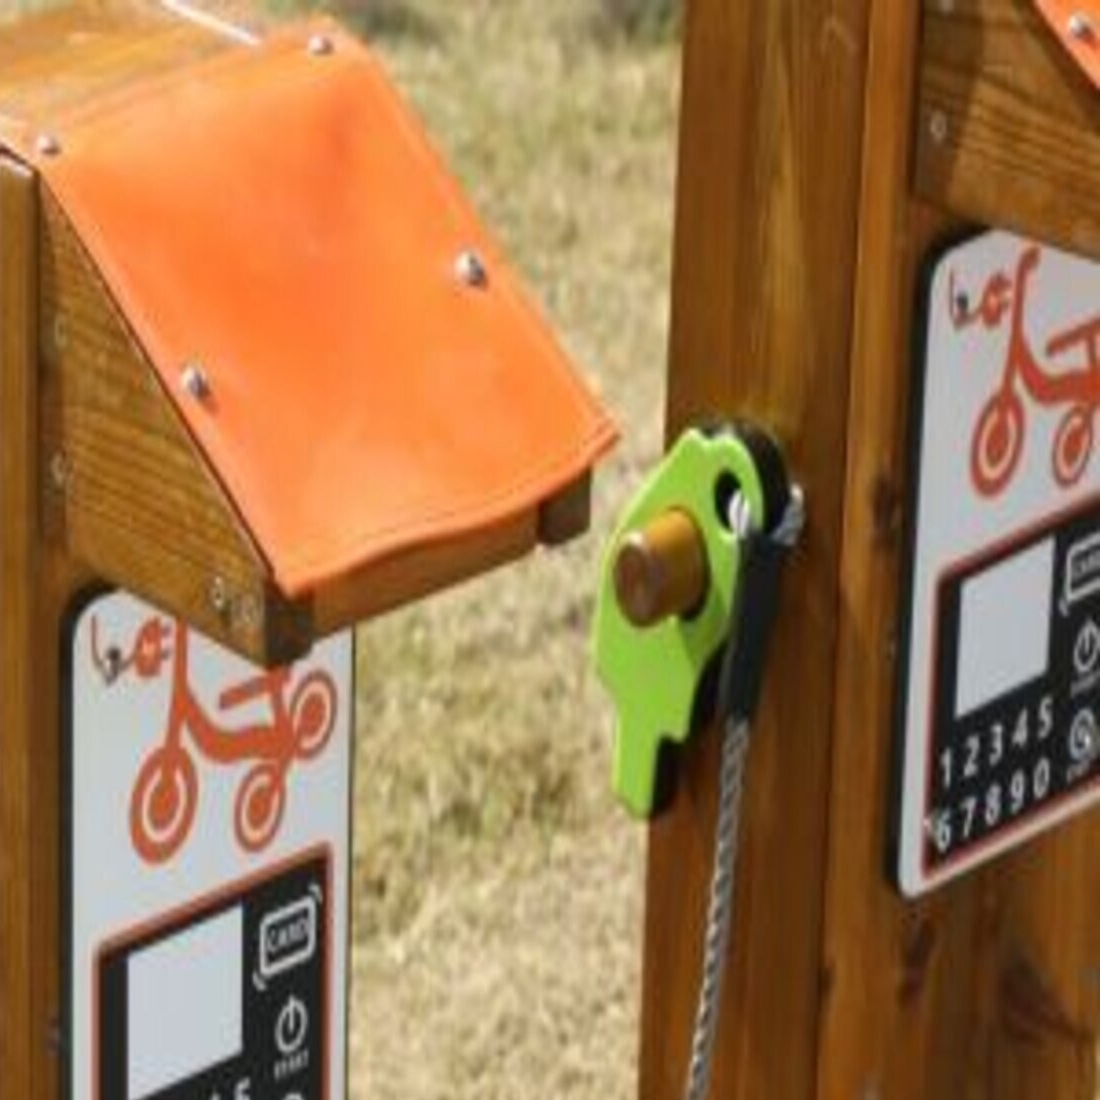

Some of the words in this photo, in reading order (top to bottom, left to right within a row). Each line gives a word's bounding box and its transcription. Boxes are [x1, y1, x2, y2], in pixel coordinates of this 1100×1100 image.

[941, 747, 951, 787] 1
[964, 734, 980, 777] 2
[990, 722, 1003, 766] 3
[1012, 707, 1028, 747] 4
[1037, 697, 1052, 739] 5
[961, 796, 977, 838] 7
[985, 784, 1001, 826] 8
[1010, 768, 1025, 812] 9
[1033, 757, 1050, 798] 0
